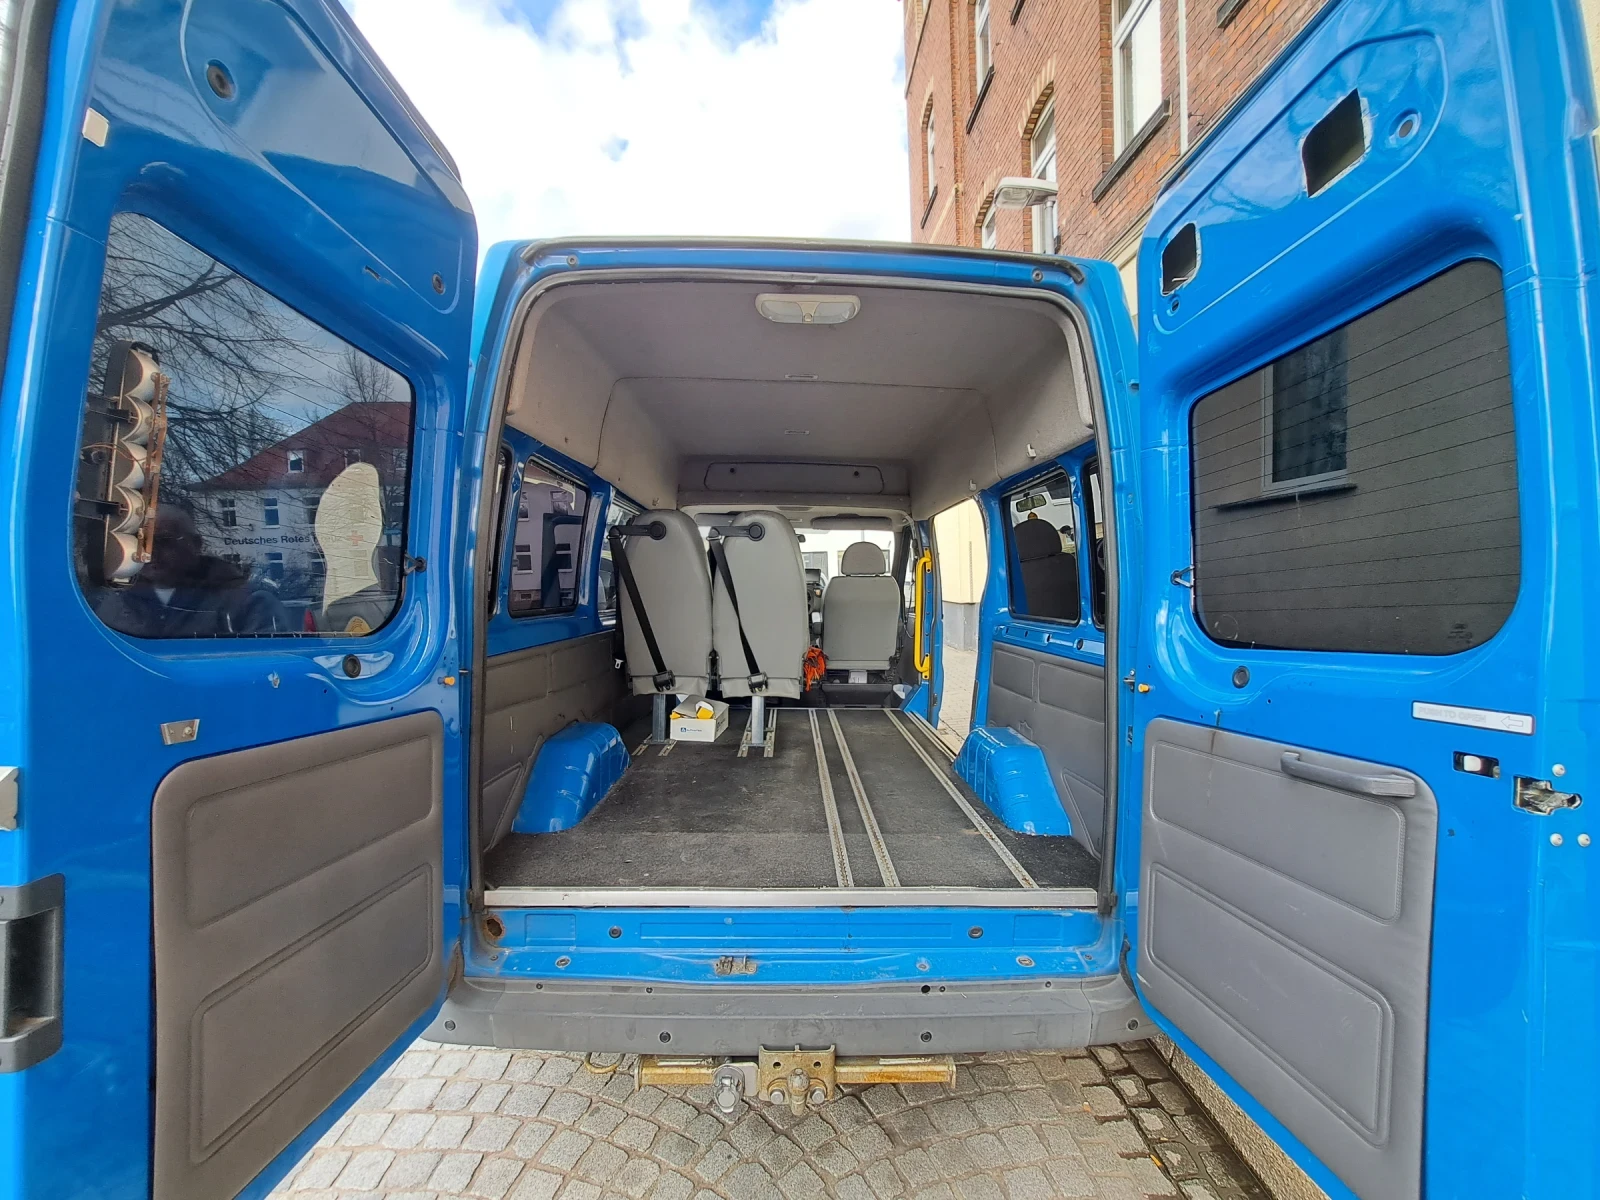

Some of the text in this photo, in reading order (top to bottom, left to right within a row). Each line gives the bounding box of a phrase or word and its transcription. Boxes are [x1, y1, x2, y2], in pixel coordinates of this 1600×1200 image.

[224, 536, 278, 546] Deutsches
[281, 535, 310, 544] Rotes
[1419, 706, 1487, 724] PUSH TO OPEN
